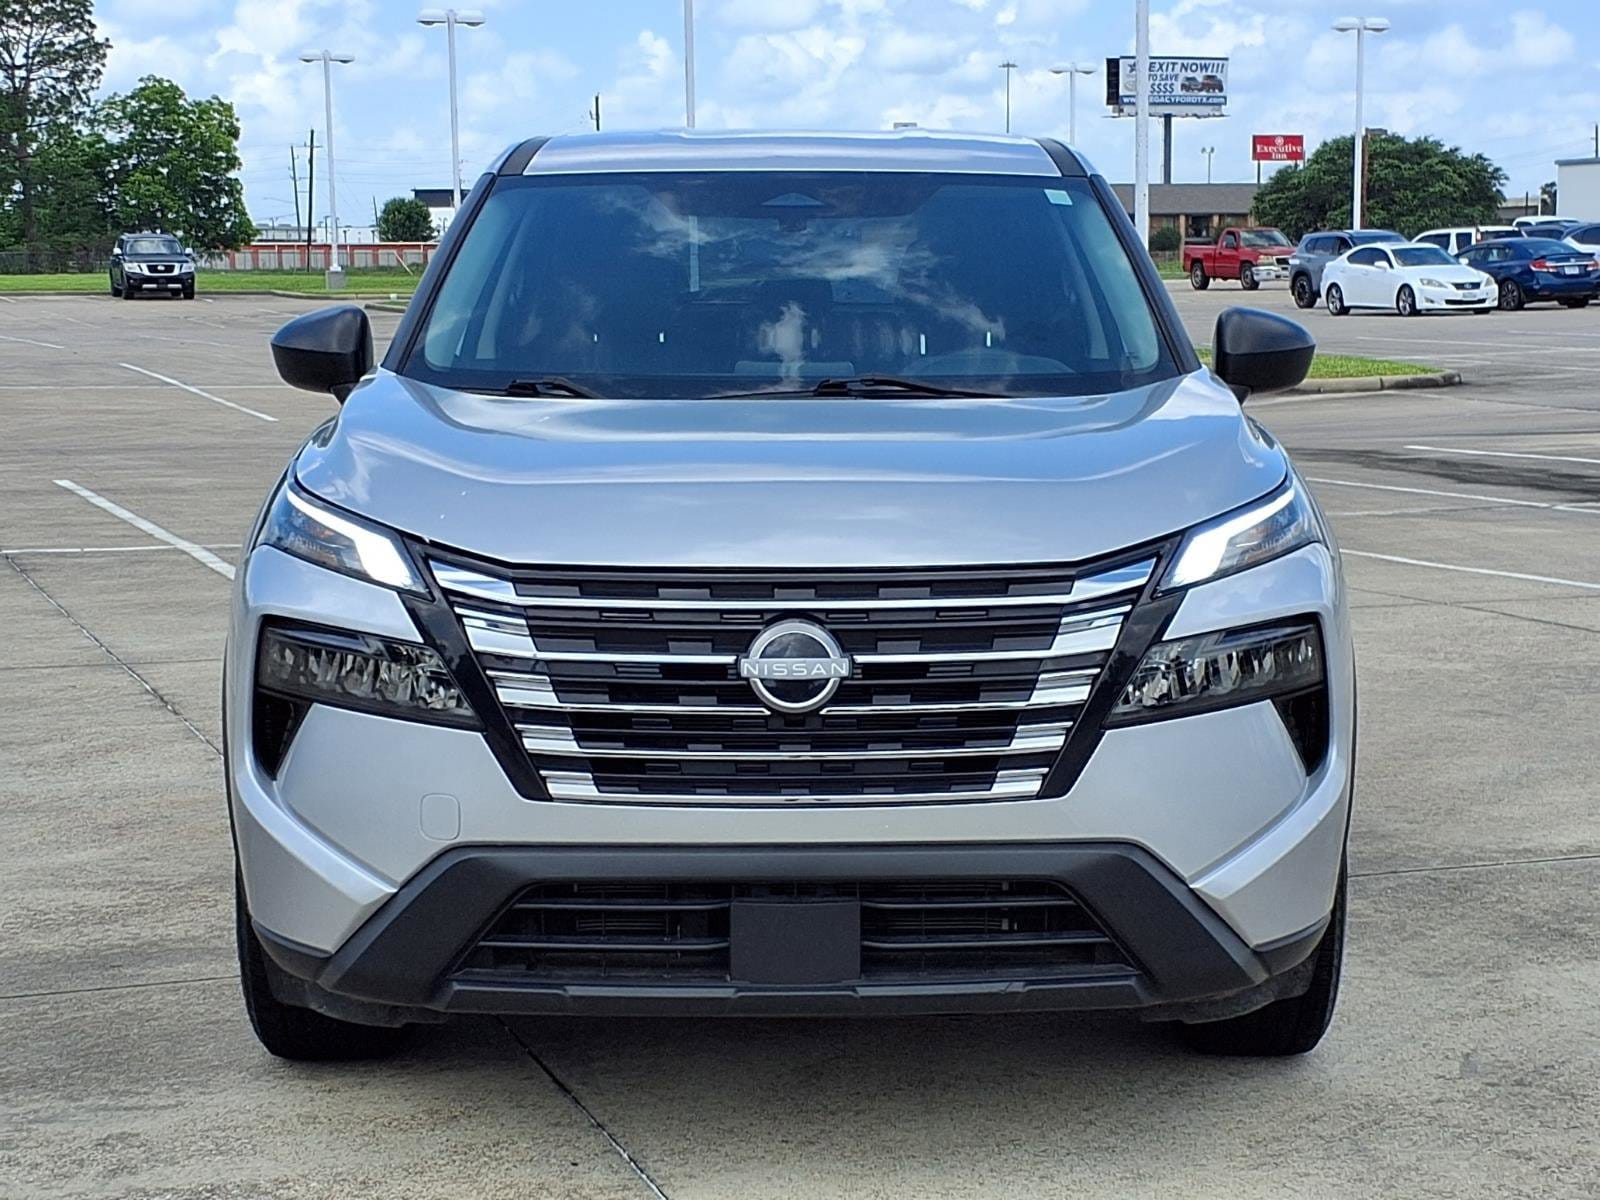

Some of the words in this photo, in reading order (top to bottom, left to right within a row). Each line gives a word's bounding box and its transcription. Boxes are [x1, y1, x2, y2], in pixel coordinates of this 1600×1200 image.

[1148, 62, 1178, 73] EXIT
[1148, 74, 1158, 82] TO
[1159, 73, 1179, 82] SAVE
[1256, 143, 1303, 153] Executive
[743, 663, 847, 677] NISSAN
